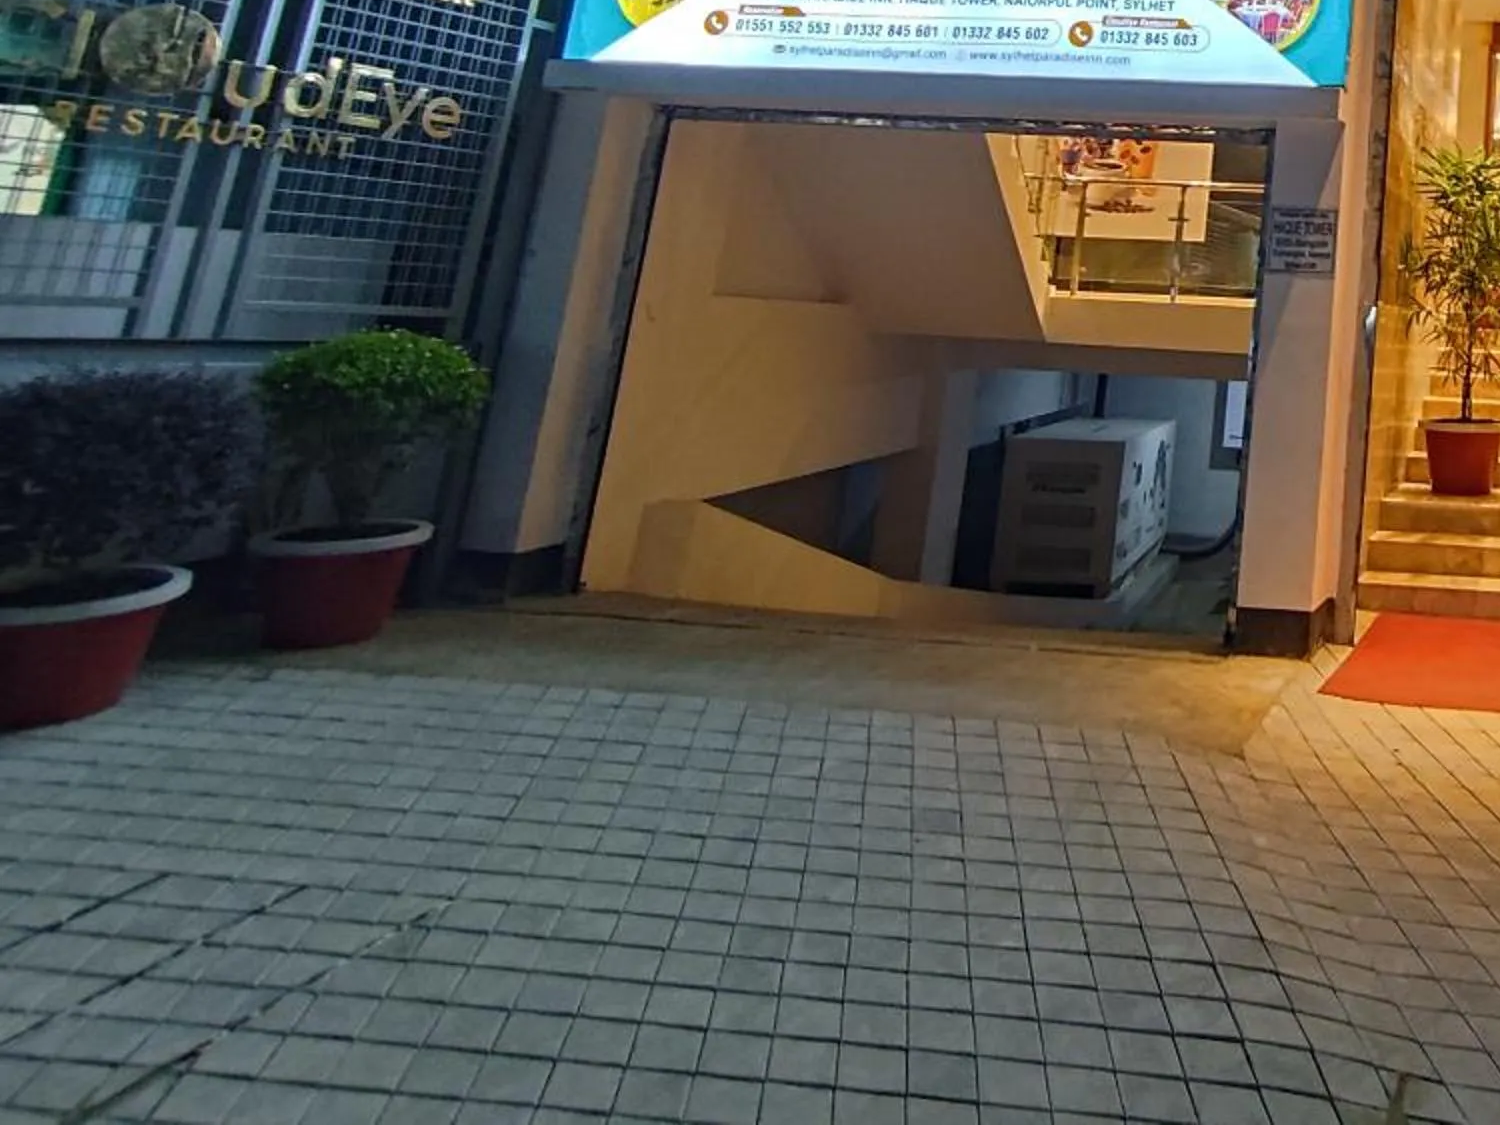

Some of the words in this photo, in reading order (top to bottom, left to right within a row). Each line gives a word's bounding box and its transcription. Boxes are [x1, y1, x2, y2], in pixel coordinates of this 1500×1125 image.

[736, 18, 773, 32] 01551
[779, 20, 803, 34] 552
[887, 24, 911, 38] 845
[996, 27, 1021, 40] 845
[1025, 27, 1050, 41] 602
[1145, 32, 1169, 46] 845
[1173, 34, 1198, 46] 603
[54, 99, 357, 161] RESTAURANT
